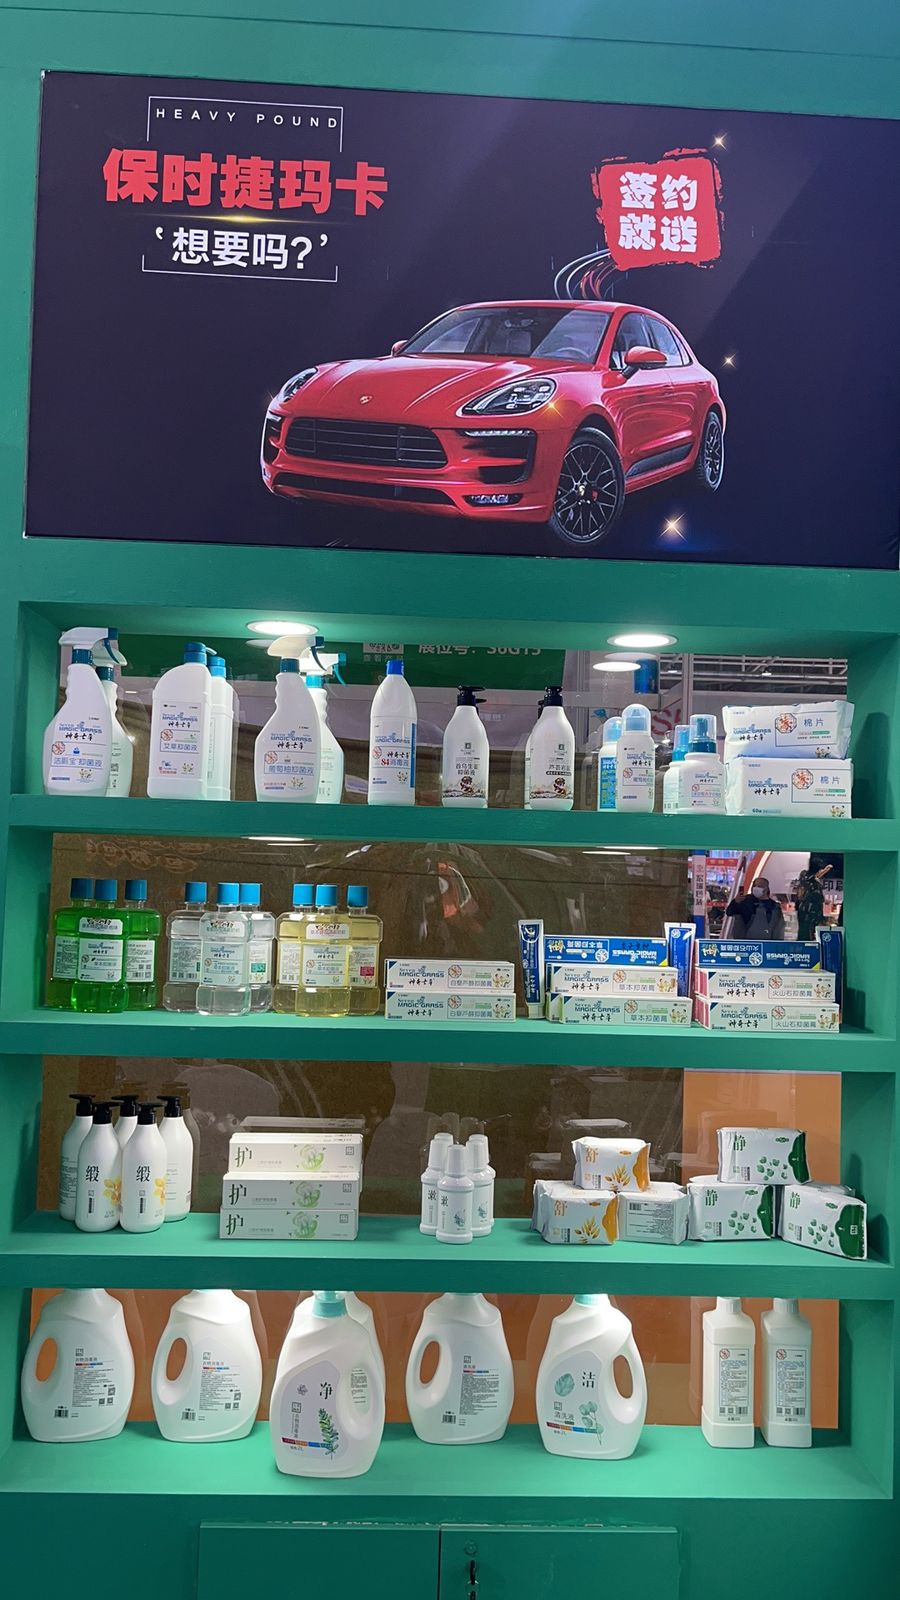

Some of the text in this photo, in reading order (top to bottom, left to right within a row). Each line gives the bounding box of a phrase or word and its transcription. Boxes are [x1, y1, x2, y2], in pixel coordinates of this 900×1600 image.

[156, 108, 338, 128] HEAVY POUND
[102, 148, 389, 217] 保时捷玛卡
[619, 171, 698, 211] 签约
[618, 213, 698, 253] 就送
[804, 718, 824, 728] 棉片
[820, 776, 840, 785] 棉片
[409, 978, 433, 986] 神奇七草
[571, 982, 600, 991] 神奇七草
[619, 984, 655, 992] 草本抑菌膏
[726, 989, 756, 997] 神奇七草
[408, 1009, 432, 1017] 神奇七草
[582, 1013, 612, 1022] 神奇七草
[630, 1015, 668, 1023] 草本抑菌膏
[728, 1020, 759, 1028] 神奇七草
[775, 1021, 816, 1029] 火山石抑菌膏
[733, 1134, 746, 1151] 静
[235, 1147, 252, 1168] 护
[229, 1184, 247, 1205] 护
[705, 1189, 718, 1206] 静
[790, 1192, 801, 1209] 静
[226, 1214, 243, 1235] 护
[582, 1371, 596, 1388] 洁
[319, 1381, 333, 1400] 净
